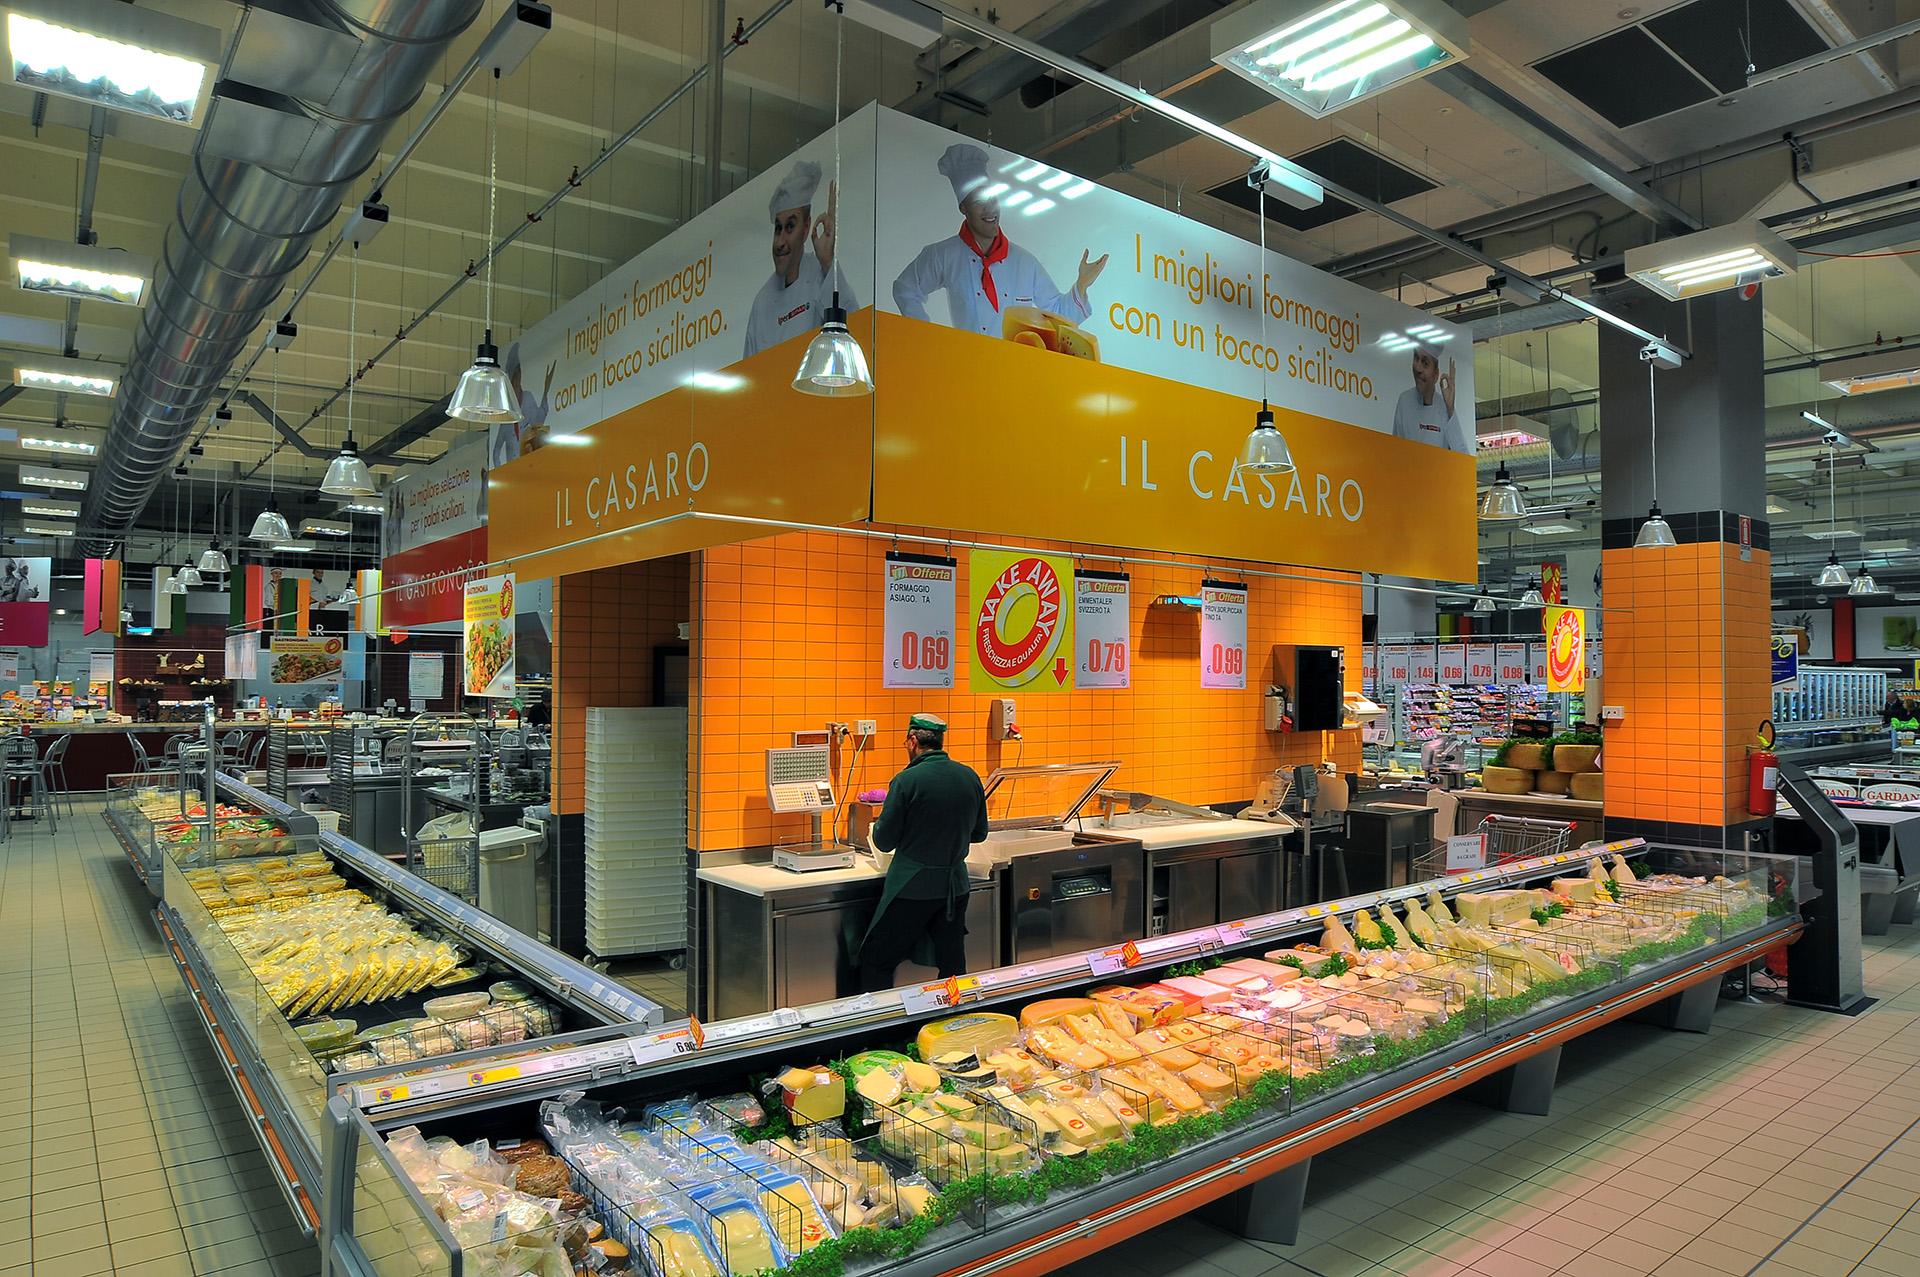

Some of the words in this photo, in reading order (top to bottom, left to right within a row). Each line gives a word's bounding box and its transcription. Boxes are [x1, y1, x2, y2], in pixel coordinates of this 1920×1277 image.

[566, 327, 571, 360] I
[574, 292, 627, 356] migliori
[632, 239, 713, 321] formaggi
[1135, 233, 1141, 273] I
[1153, 249, 1252, 310] migliori
[1263, 273, 1361, 353] formaggi
[554, 383, 577, 412] con
[581, 371, 597, 399] un
[602, 349, 642, 388] tocco
[648, 308, 728, 367] siciliano.
[1109, 302, 1161, 340] con
[1173, 319, 1205, 352] un
[1214, 323, 1280, 373] tocco
[1288, 344, 1379, 401] siciliano.
[409, 488, 417, 507] La
[417, 478, 440, 507] migliore
[440, 467, 470, 495] selezione
[556, 487, 573, 529] IL
[586, 441, 709, 520] CASARO
[1120, 435, 1158, 491] IL
[1188, 449, 1364, 522] CASARO
[410, 518, 420, 539] per
[423, 504, 441, 535] palati
[889, 583, 931, 593] FORMAGGIO
[912, 567, 951, 580] Offerta
[1094, 582, 1126, 593] Offerta
[922, 596, 931, 604] TA
[979, 564, 1020, 627] TAKE
[1026, 561, 1058, 637] AWAY
[1078, 597, 1113, 605] EMMENTALER
[1218, 592, 1245, 603] Offerta
[893, 658, 899, 669] €
[902, 631, 949, 670] 0,69
[982, 627, 1012, 668] FRESCHEZZA
[1551, 614, 1566, 652] TAKE
[1566, 611, 1580, 658] AWAY
[1082, 663, 1087, 672] €
[1089, 639, 1125, 672] 0,79
[1206, 664, 1211, 674] €
